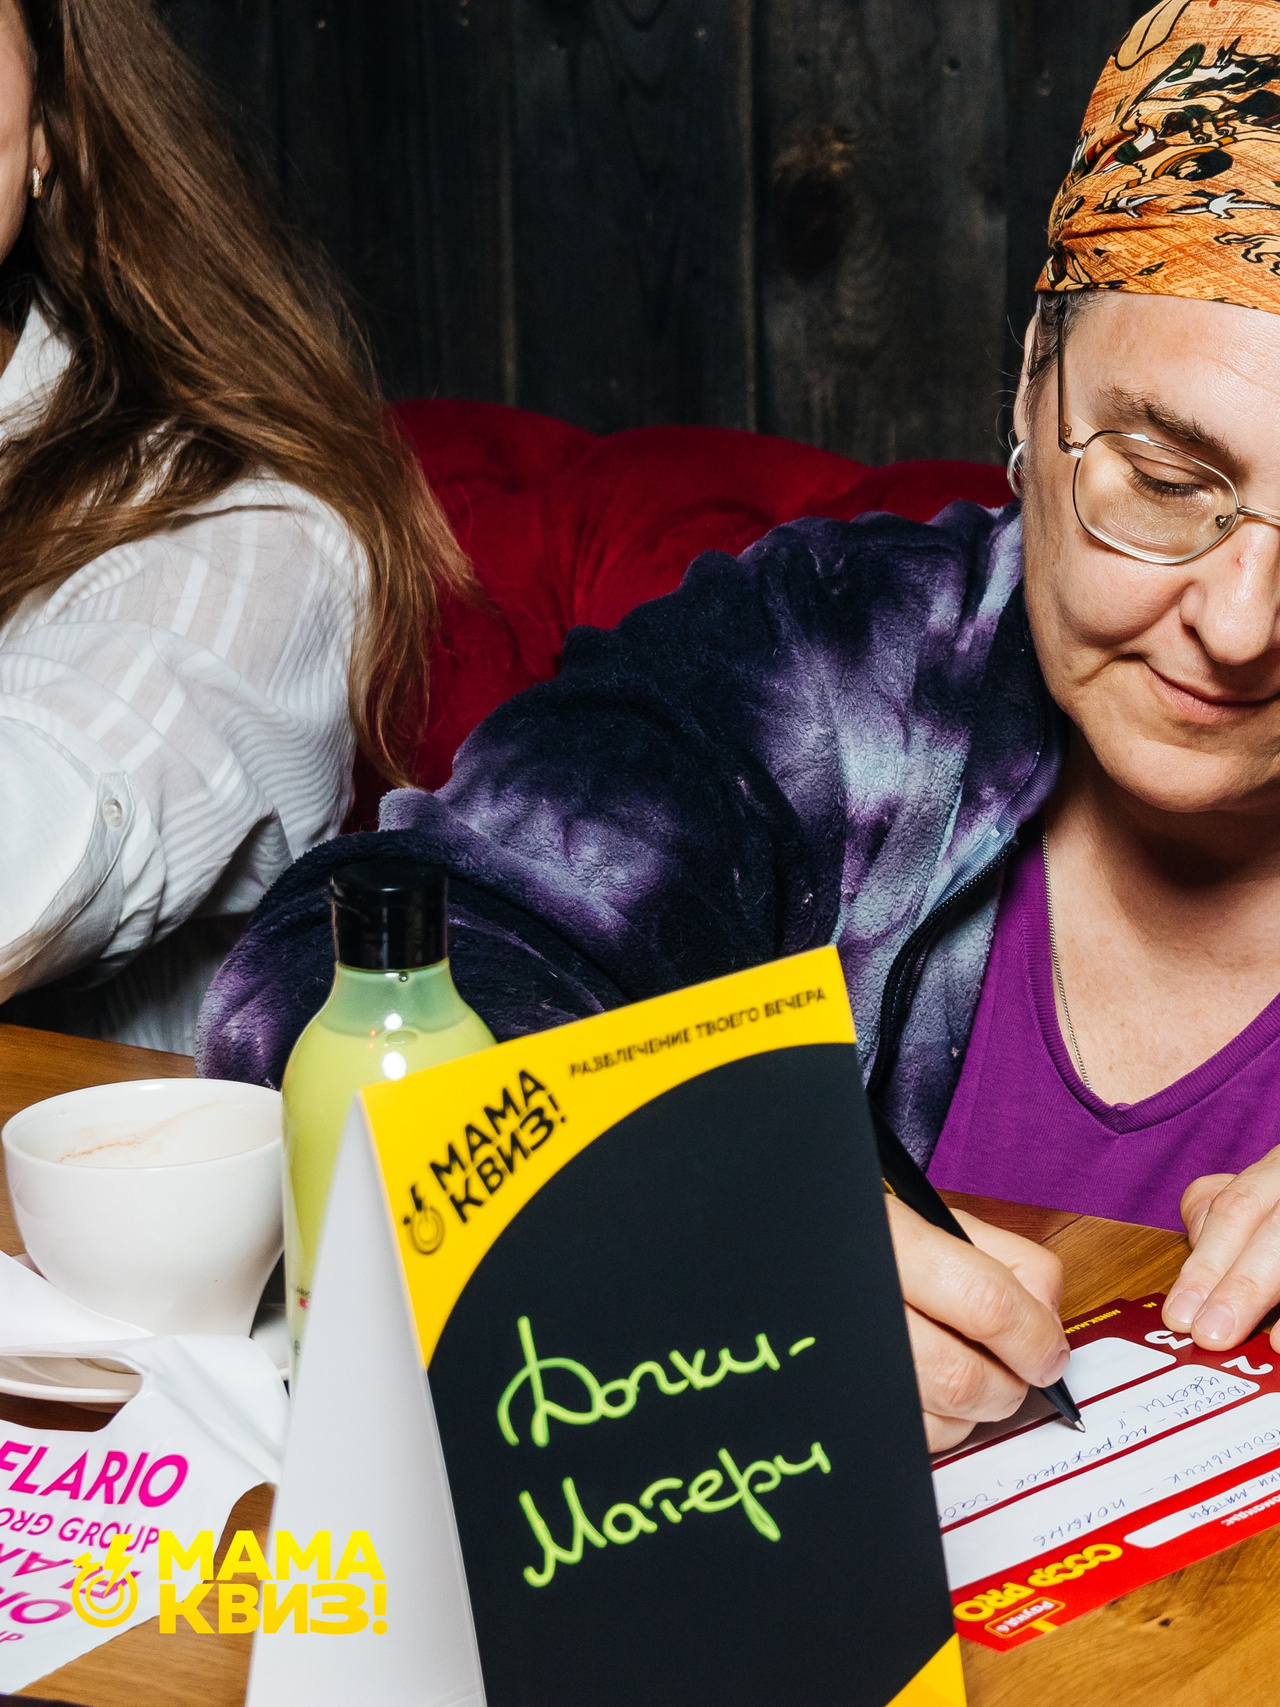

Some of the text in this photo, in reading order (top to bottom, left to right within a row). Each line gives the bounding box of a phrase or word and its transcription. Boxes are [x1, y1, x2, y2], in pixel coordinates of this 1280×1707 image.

[570, 988, 826, 1078] РАЗВЛЕЧЕНИЕ ТВОЕГО ВЕЧЕРА
[429, 1069, 547, 1190] МАМА
[448, 1094, 567, 1223] КВИЗ!
[1144, 1330, 1193, 1350] 3
[1221, 1355, 1273, 1375] 2
[497, 1315, 816, 1447] Дочки-
[58, 1517, 159, 1553] GROUP
[518, 1442, 831, 1587] Матери
[953, 1582, 1035, 1622] PRO
[1004, 1600, 1054, 1628] Раунд
